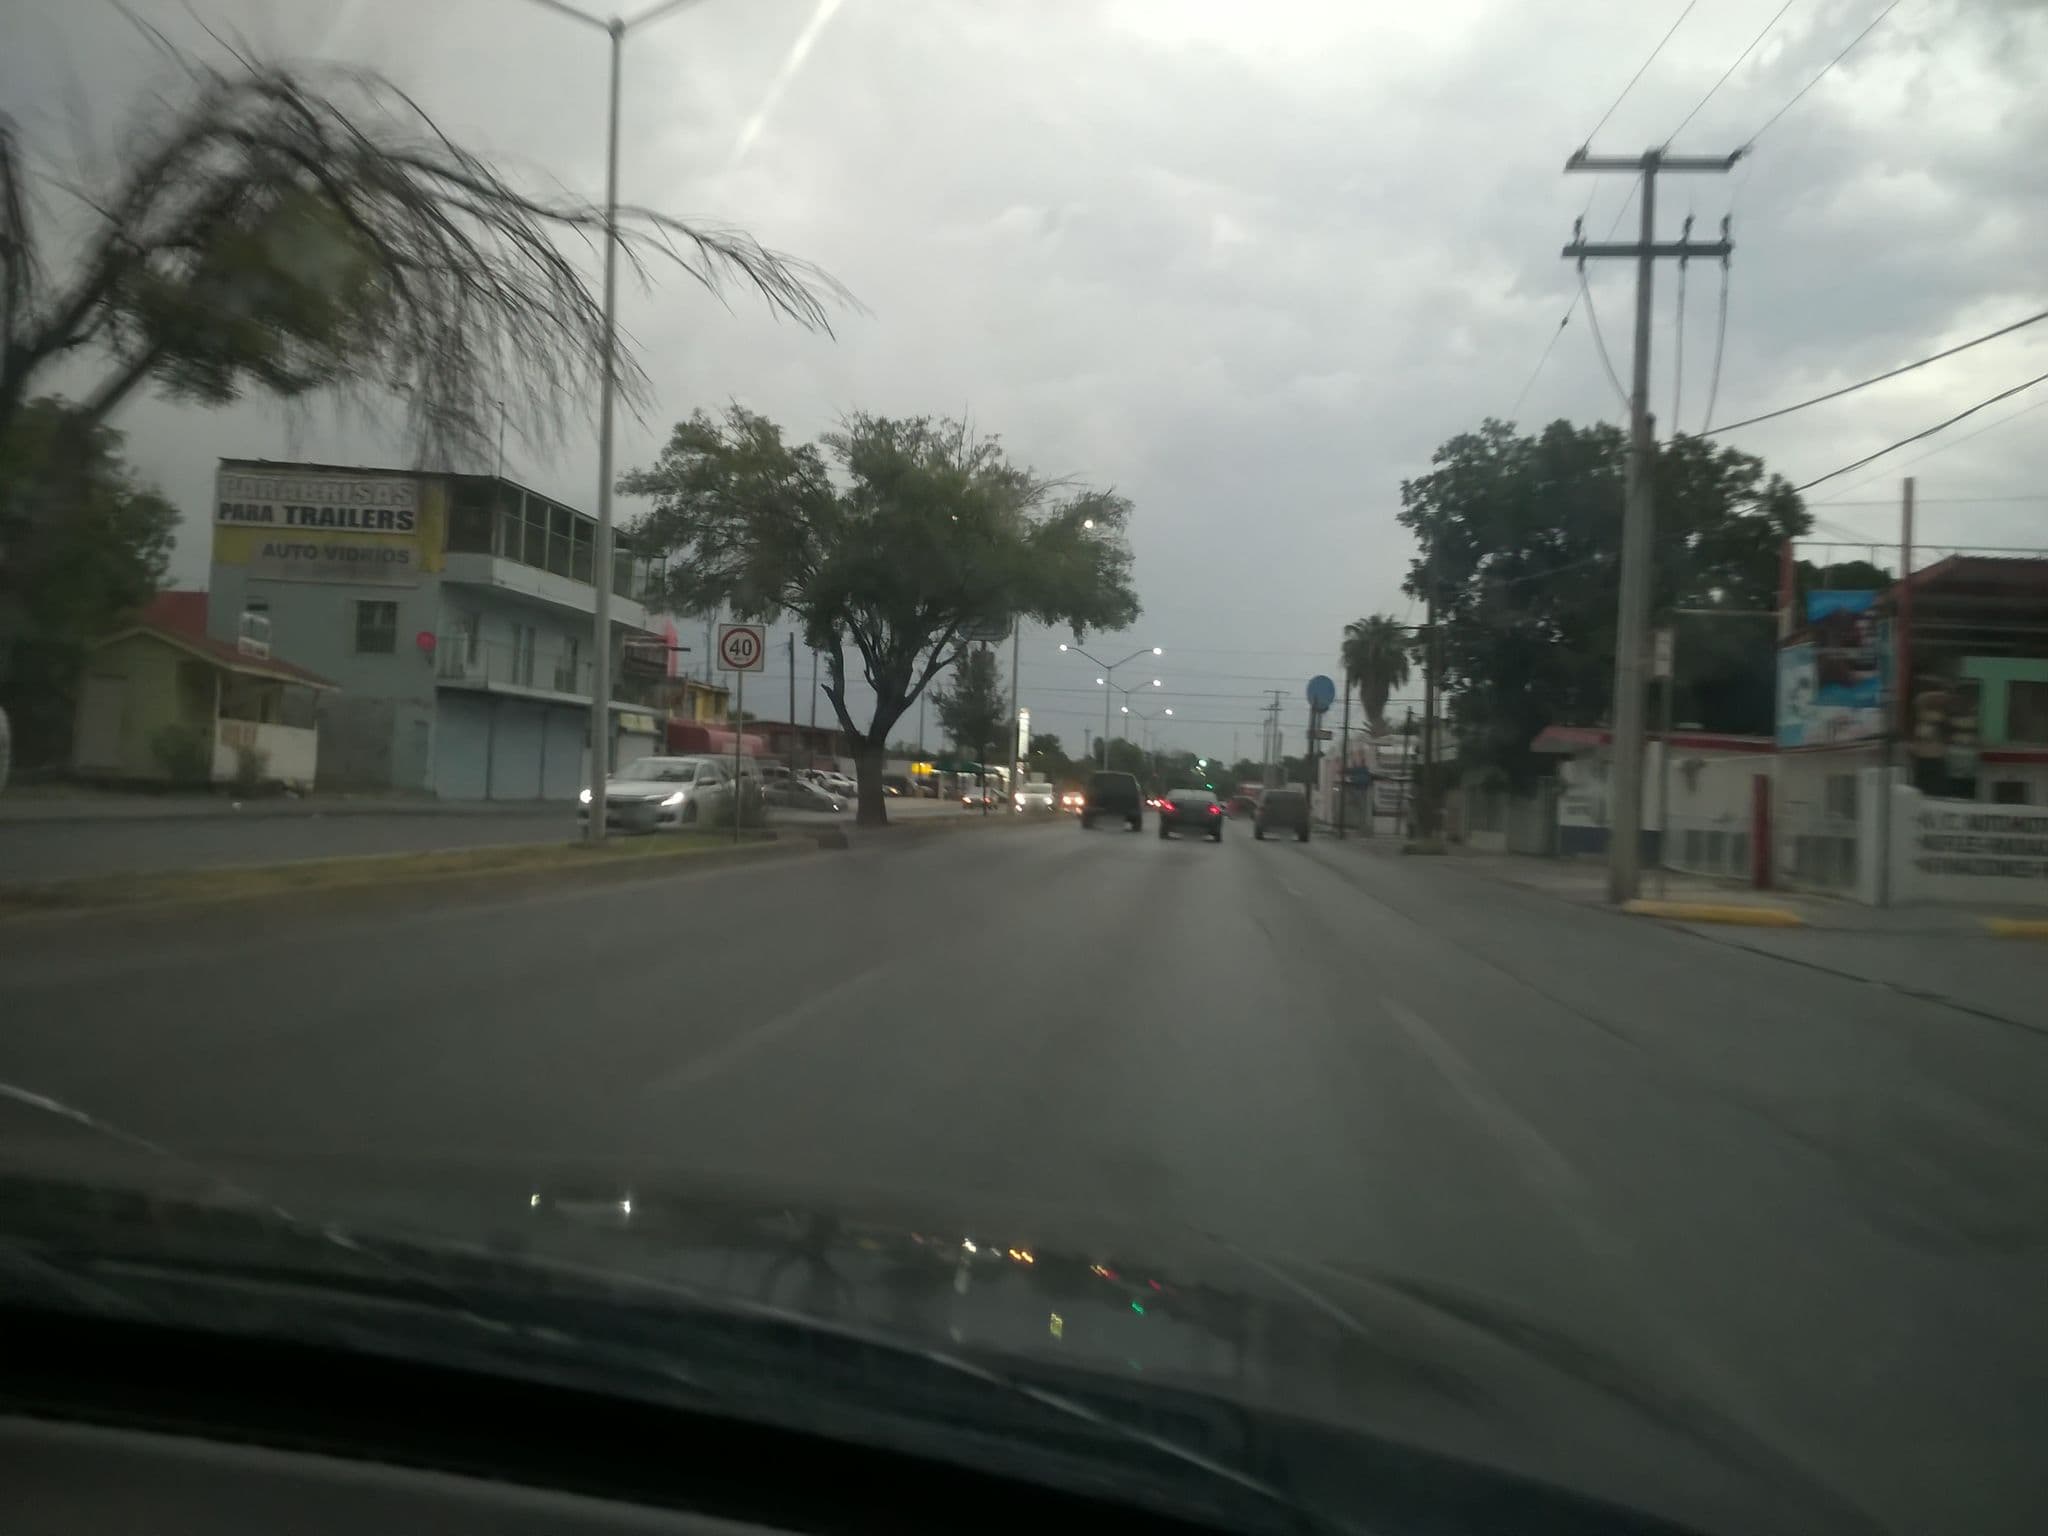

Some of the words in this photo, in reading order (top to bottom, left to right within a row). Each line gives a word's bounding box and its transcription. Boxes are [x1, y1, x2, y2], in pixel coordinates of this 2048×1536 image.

[219, 503, 273, 522] PARA
[283, 506, 415, 530] TRAILERS
[262, 543, 318, 560] AUTO
[323, 544, 409, 564] VIDRIOS
[729, 639, 752, 656] 40
